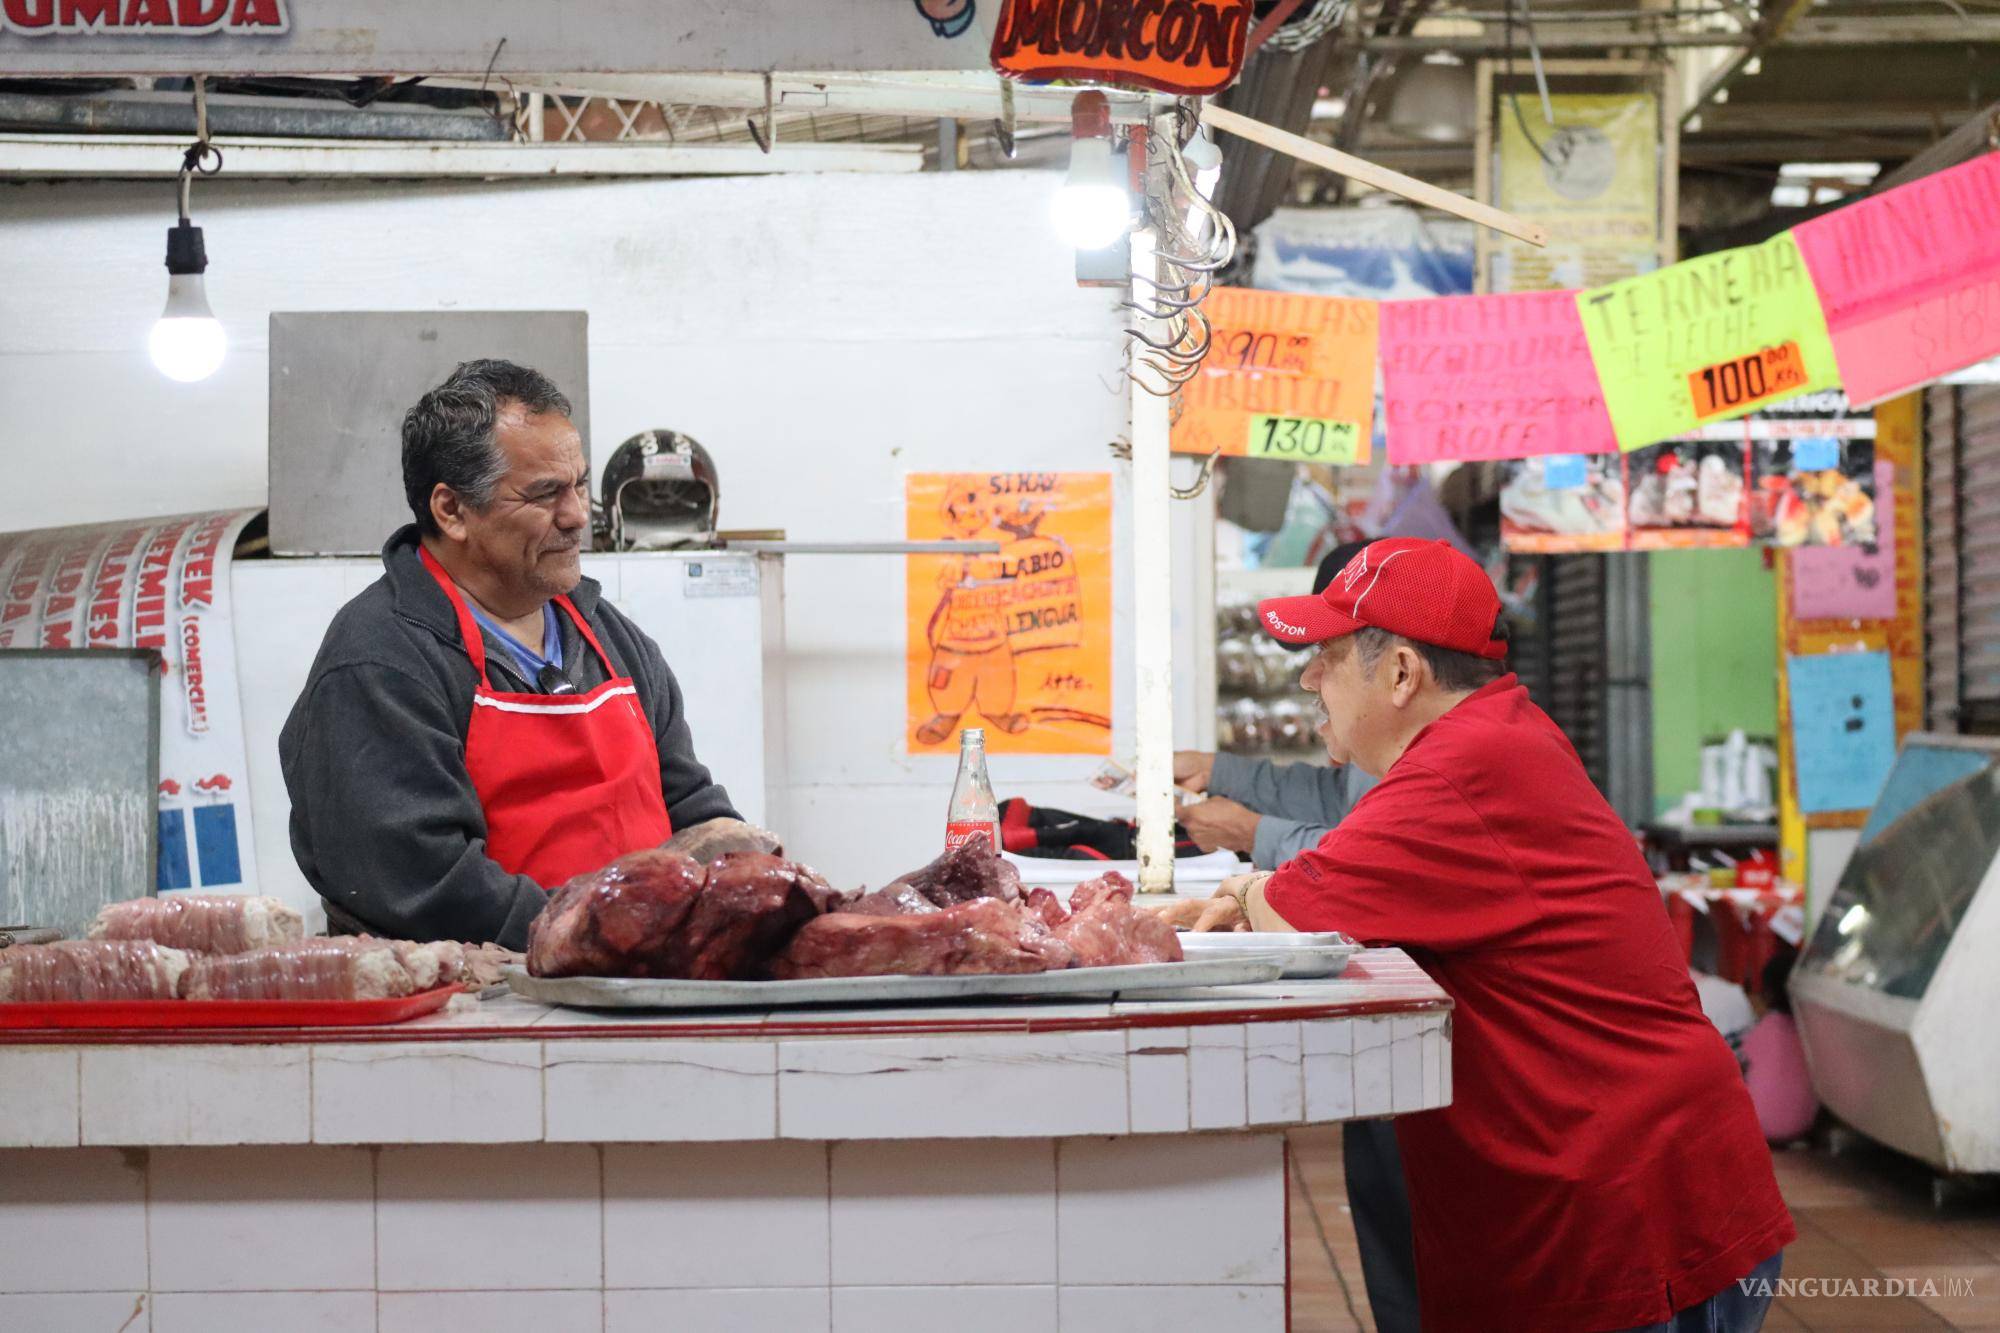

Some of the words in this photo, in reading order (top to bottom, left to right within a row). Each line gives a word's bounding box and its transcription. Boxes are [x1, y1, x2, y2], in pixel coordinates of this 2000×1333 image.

[1263, 418, 1326, 456] 130
[1001, 550, 1064, 579] LABIO
[1006, 602, 1078, 636] LENGUA
[1266, 610, 1307, 636] BOSTON
